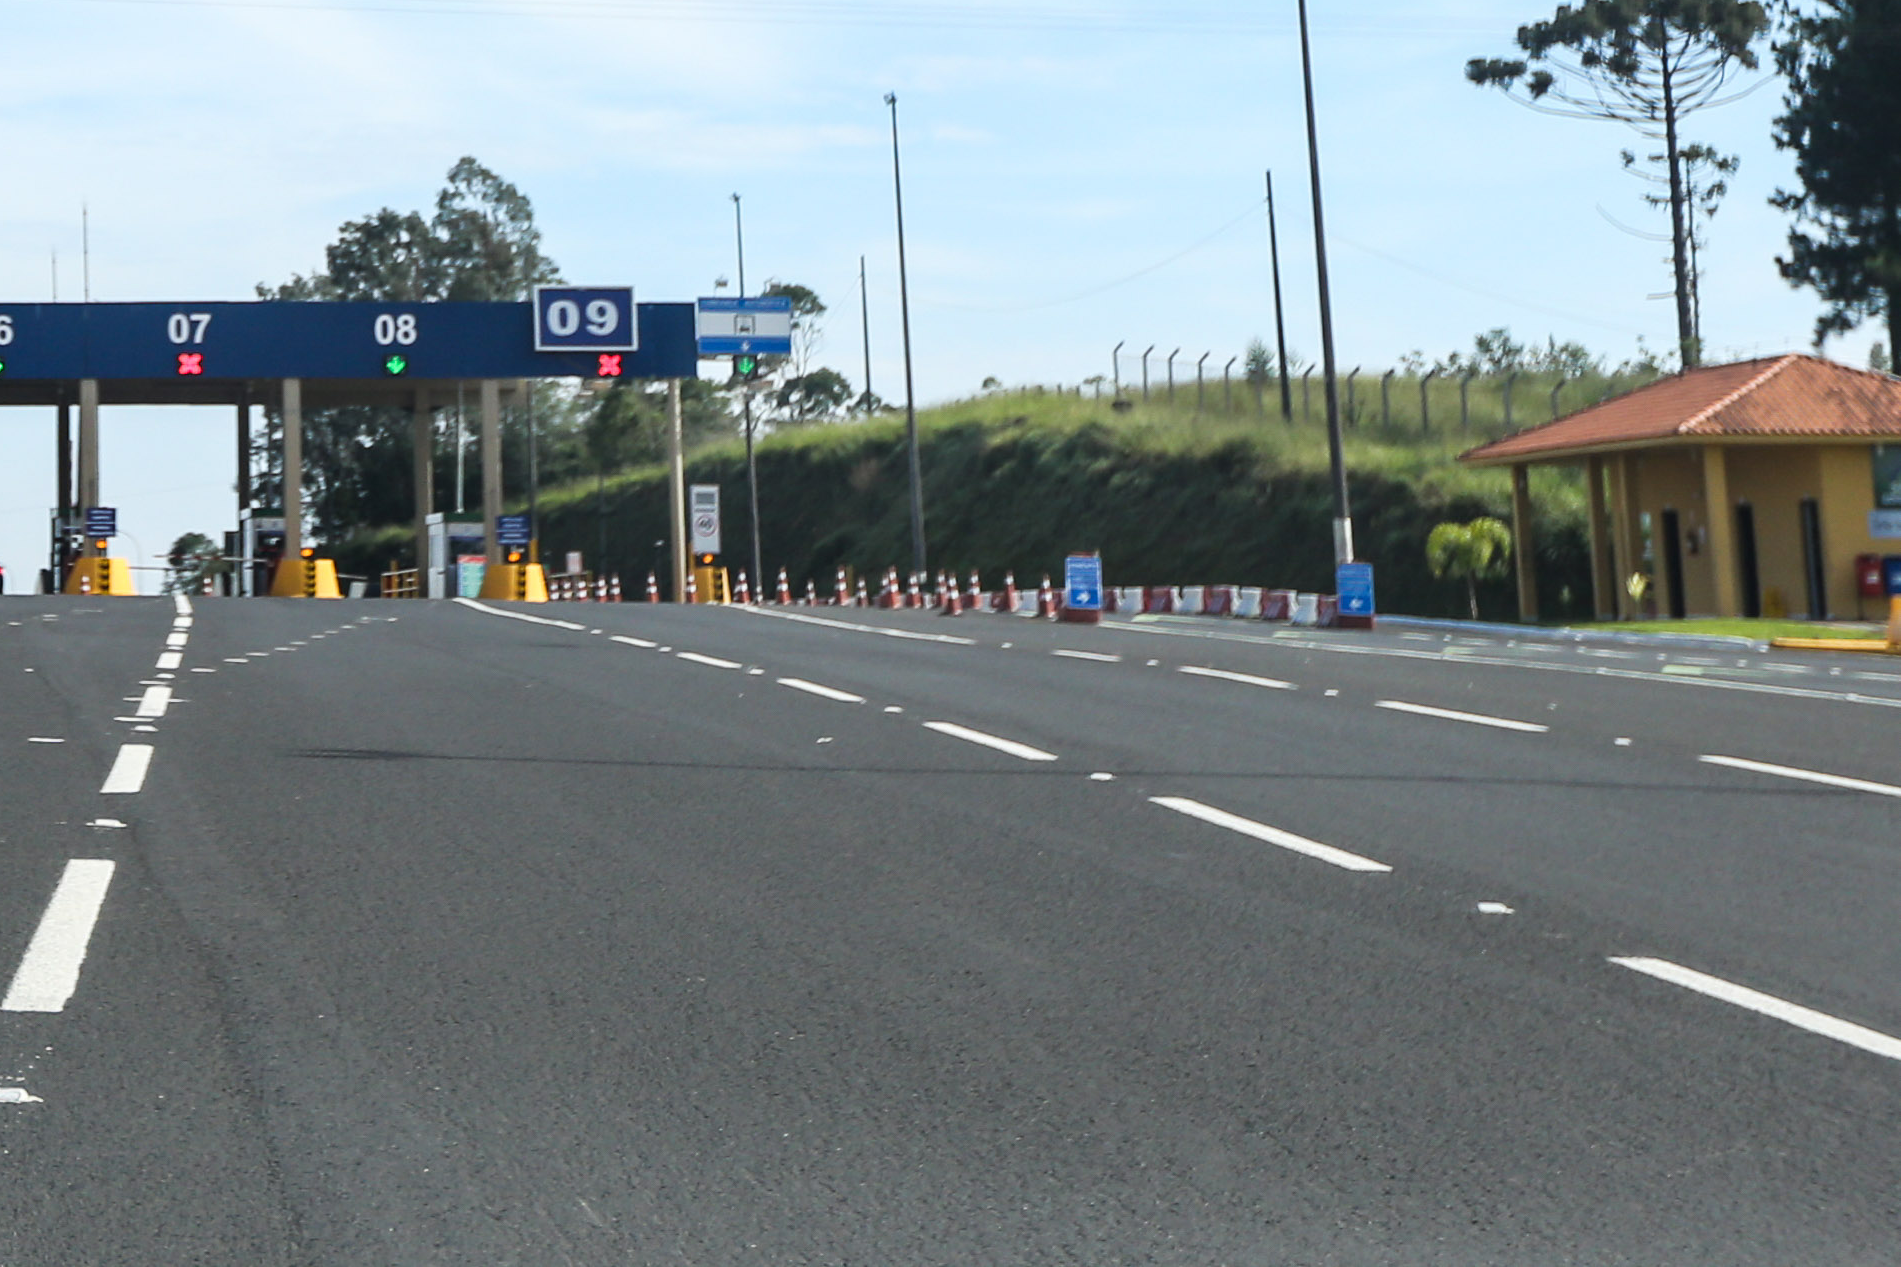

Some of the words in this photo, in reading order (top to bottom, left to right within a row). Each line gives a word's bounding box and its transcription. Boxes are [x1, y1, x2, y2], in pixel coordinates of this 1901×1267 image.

[167, 313, 212, 344] 07
[374, 314, 417, 345] 08
[546, 299, 619, 337] 09
